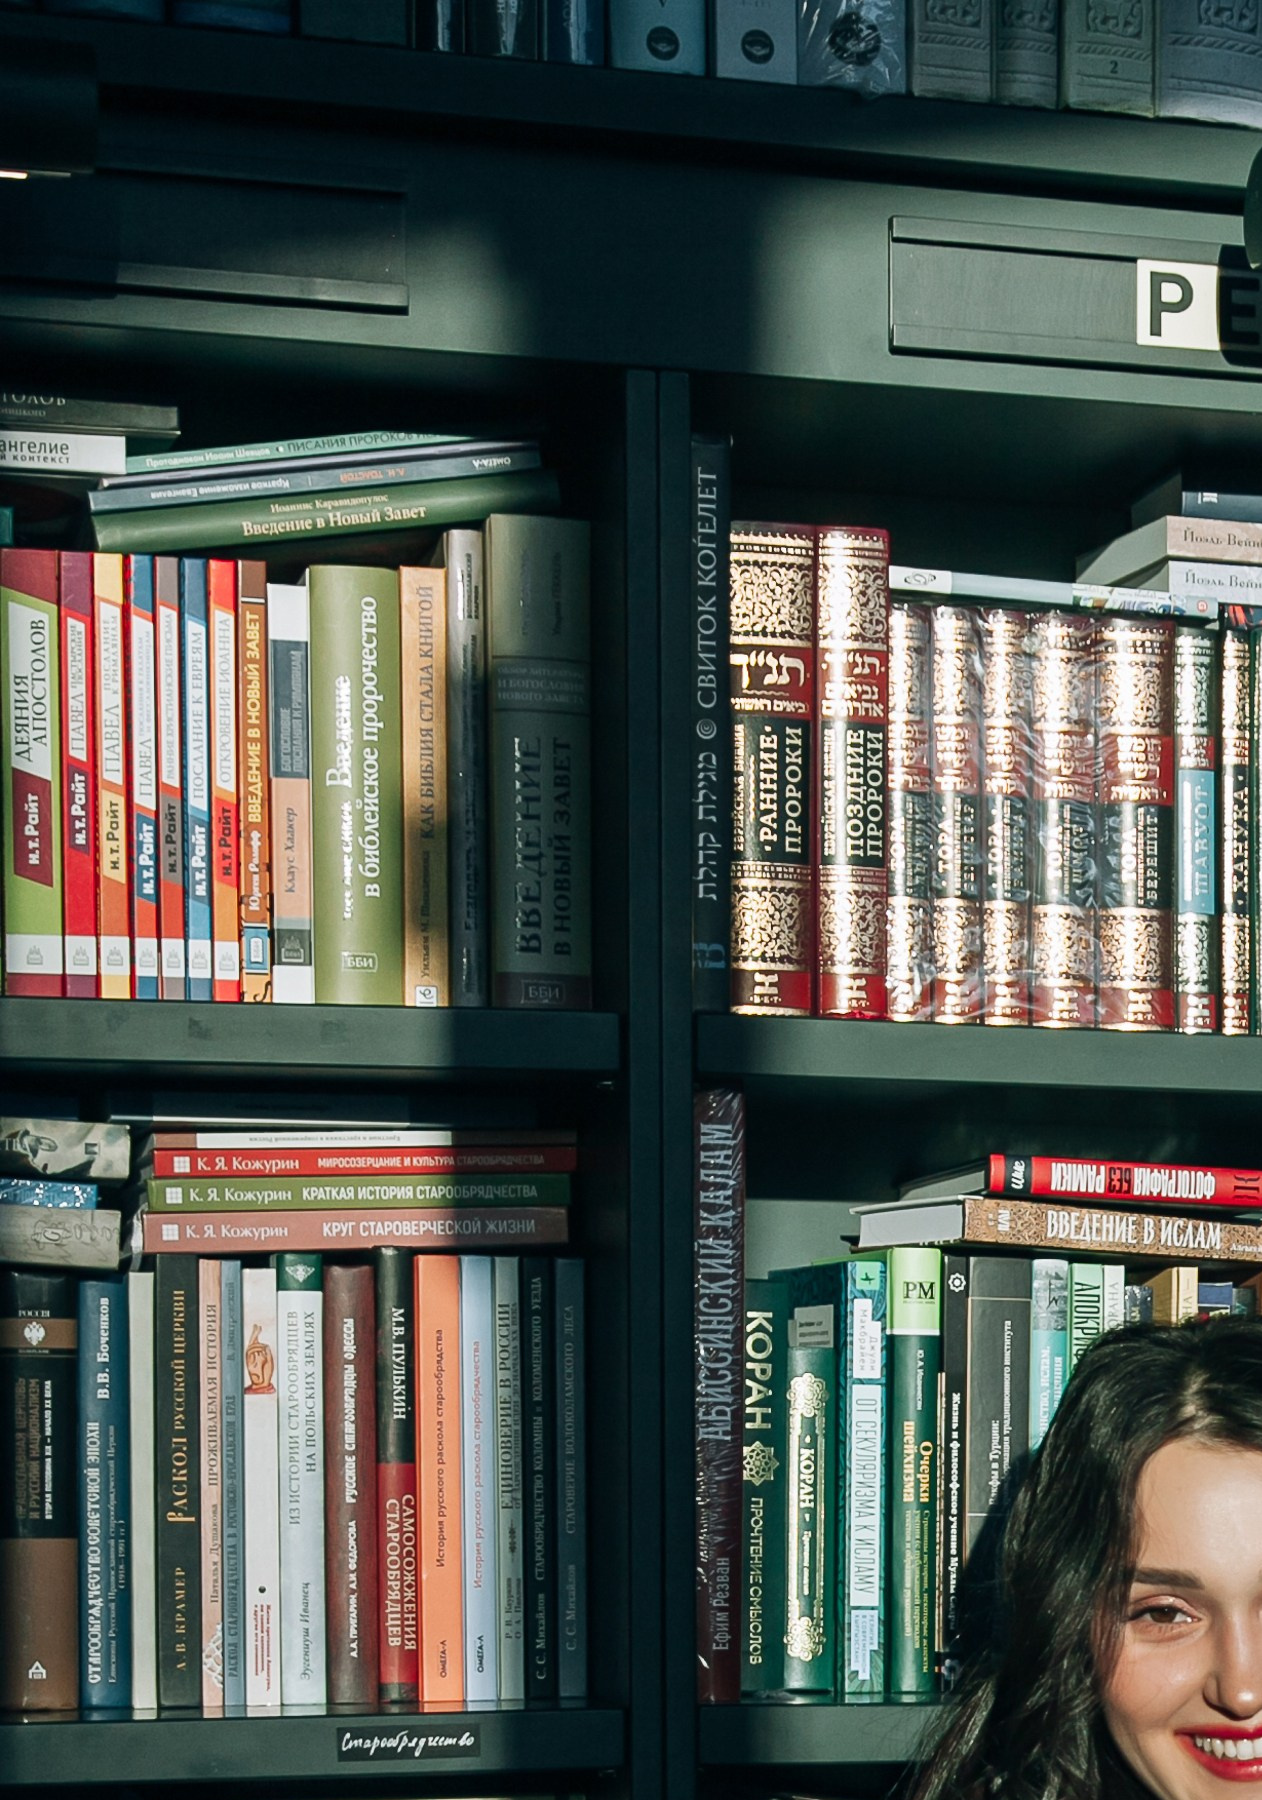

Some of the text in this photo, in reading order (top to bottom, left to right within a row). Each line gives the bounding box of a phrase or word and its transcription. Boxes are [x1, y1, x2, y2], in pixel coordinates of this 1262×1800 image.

[13, 455, 70, 463] контекст
[287, 438, 346, 453] ПИСАНИЯ
[242, 505, 426, 537] Введение в Новый Завет
[698, 466, 717, 708] СВИТОК КОГЕЛЕТ
[30, 620, 47, 746] АПОСТОЛОВ
[414, 586, 435, 839] КАК БИБЛИЯ СТАЛА КНИГОЙ
[14, 675, 32, 762] ДЕЯНИЯ
[70, 693, 84, 750] ПАВЕЛ
[191, 632, 204, 799] ПОСЛАНИЕ К ЕВРЕЯМ
[244, 612, 262, 822] ВВЕДЕНИЕ В НОВЫЙ ЗАВЕТ
[326, 676, 352, 788] Введение
[356, 597, 383, 898] в библейское пророчество
[784, 727, 802, 854] ПРОРОКИ
[225, 1188, 291, 1203] Кожурин
[302, 1185, 354, 1200] КРАТКАЯ
[358, 1185, 413, 1200] ИСТОРИЯ
[416, 1184, 538, 1200] СТАРООБРЯДЧЕСТВА
[1051, 1162, 1215, 1199] ФОТОГРАФИЯ БЕЗ РАМКИ
[323, 1217, 535, 1237] КРУГ СТАРОВЕРЧЕСКОЙ ЖИЗНИ
[1046, 1211, 1222, 1248] ВВЕДЕНИЕ В ИСЛАМ
[172, 1289, 187, 1353] ЦЕРКВИ
[172, 1359, 186, 1430] РУССКОЙ
[435, 1421, 445, 1465] раскола
[435, 1469, 448, 1518] русского
[402, 1494, 416, 1650] САМОСОЖЖЕНИЯ
[435, 1521, 446, 1567] История
[855, 1539, 875, 1594] ИСЛАМУ
